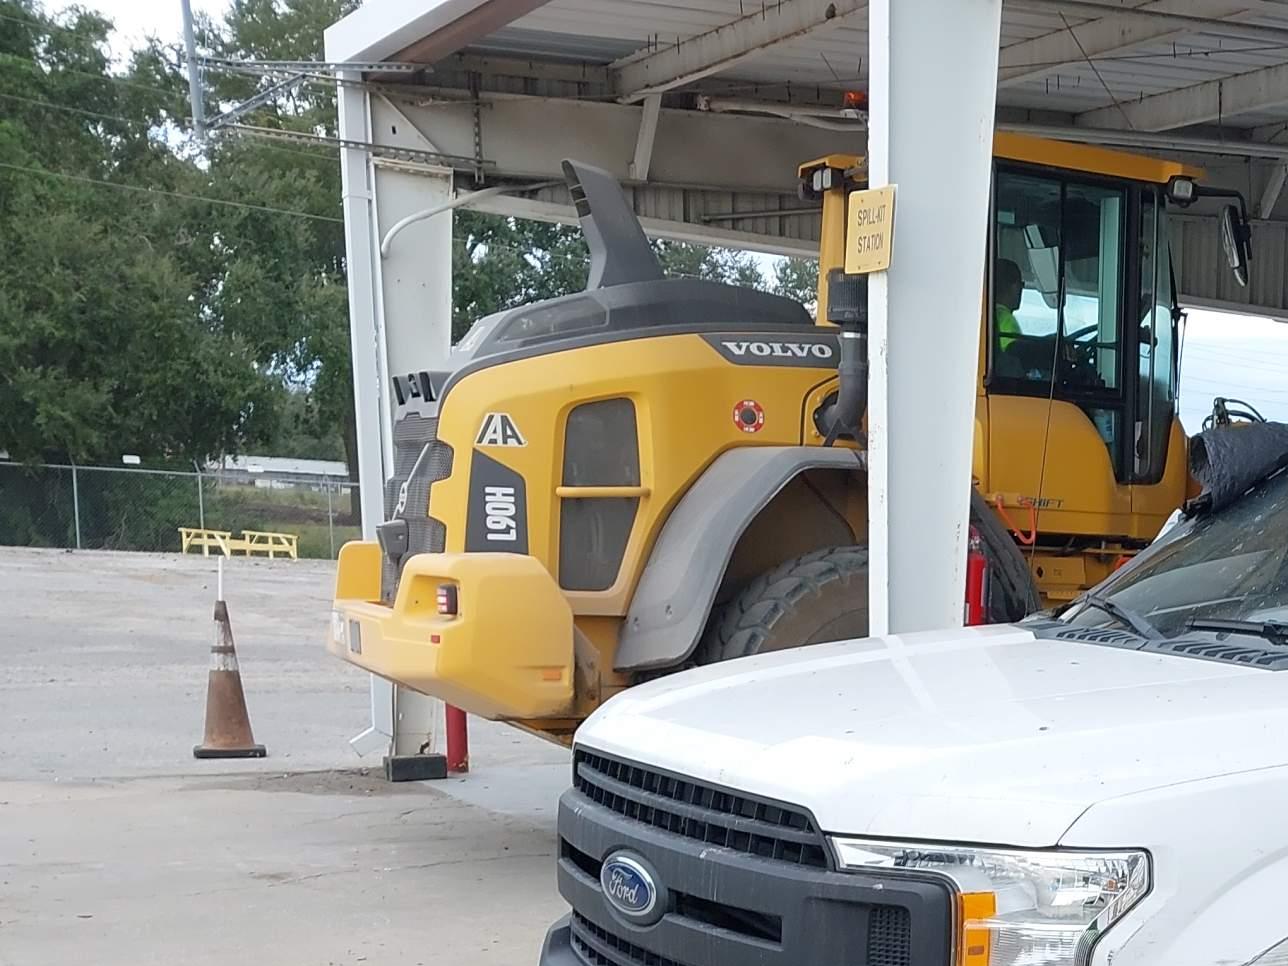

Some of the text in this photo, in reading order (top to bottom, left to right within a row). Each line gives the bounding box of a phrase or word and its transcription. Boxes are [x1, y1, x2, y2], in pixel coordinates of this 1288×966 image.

[857, 232, 884, 254] STATION
[721, 341, 833, 358] VOLVO
[484, 486, 517, 541] L90H
[608, 867, 640, 904] Ford
